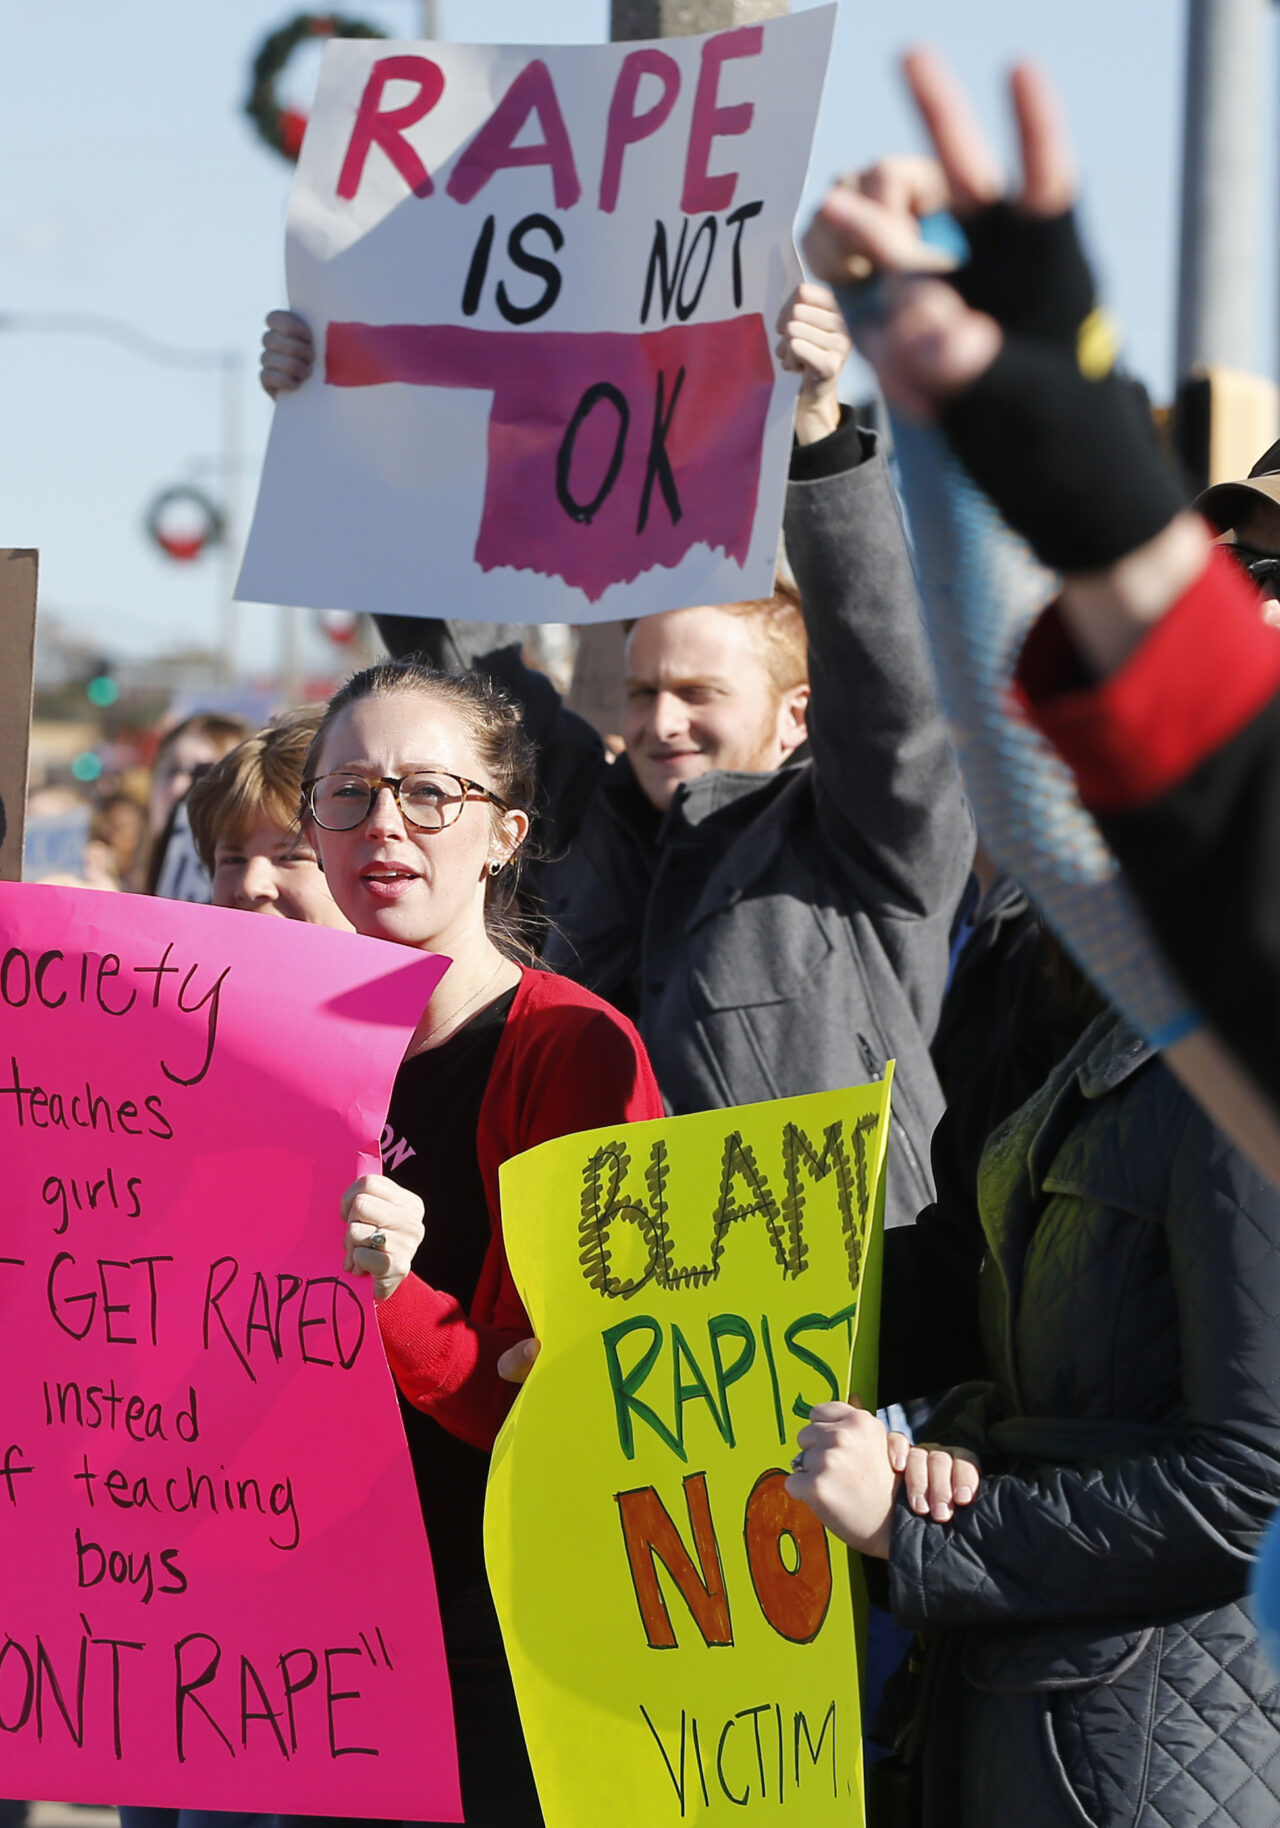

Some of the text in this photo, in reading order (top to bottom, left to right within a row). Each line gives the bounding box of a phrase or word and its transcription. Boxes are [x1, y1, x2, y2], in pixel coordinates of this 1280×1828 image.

[336, 26, 764, 214] RAPE
[461, 200, 764, 325] IS NOT
[556, 366, 686, 535] OK
[42, 1168, 142, 1234] girls
[48, 1251, 174, 1347] GET
[202, 1256, 365, 1384] RAPED
[43, 1380, 200, 1442] instead
[74, 1454, 300, 1551] teaching
[612, 1467, 833, 1649] NO
[75, 1527, 188, 1604] boys
